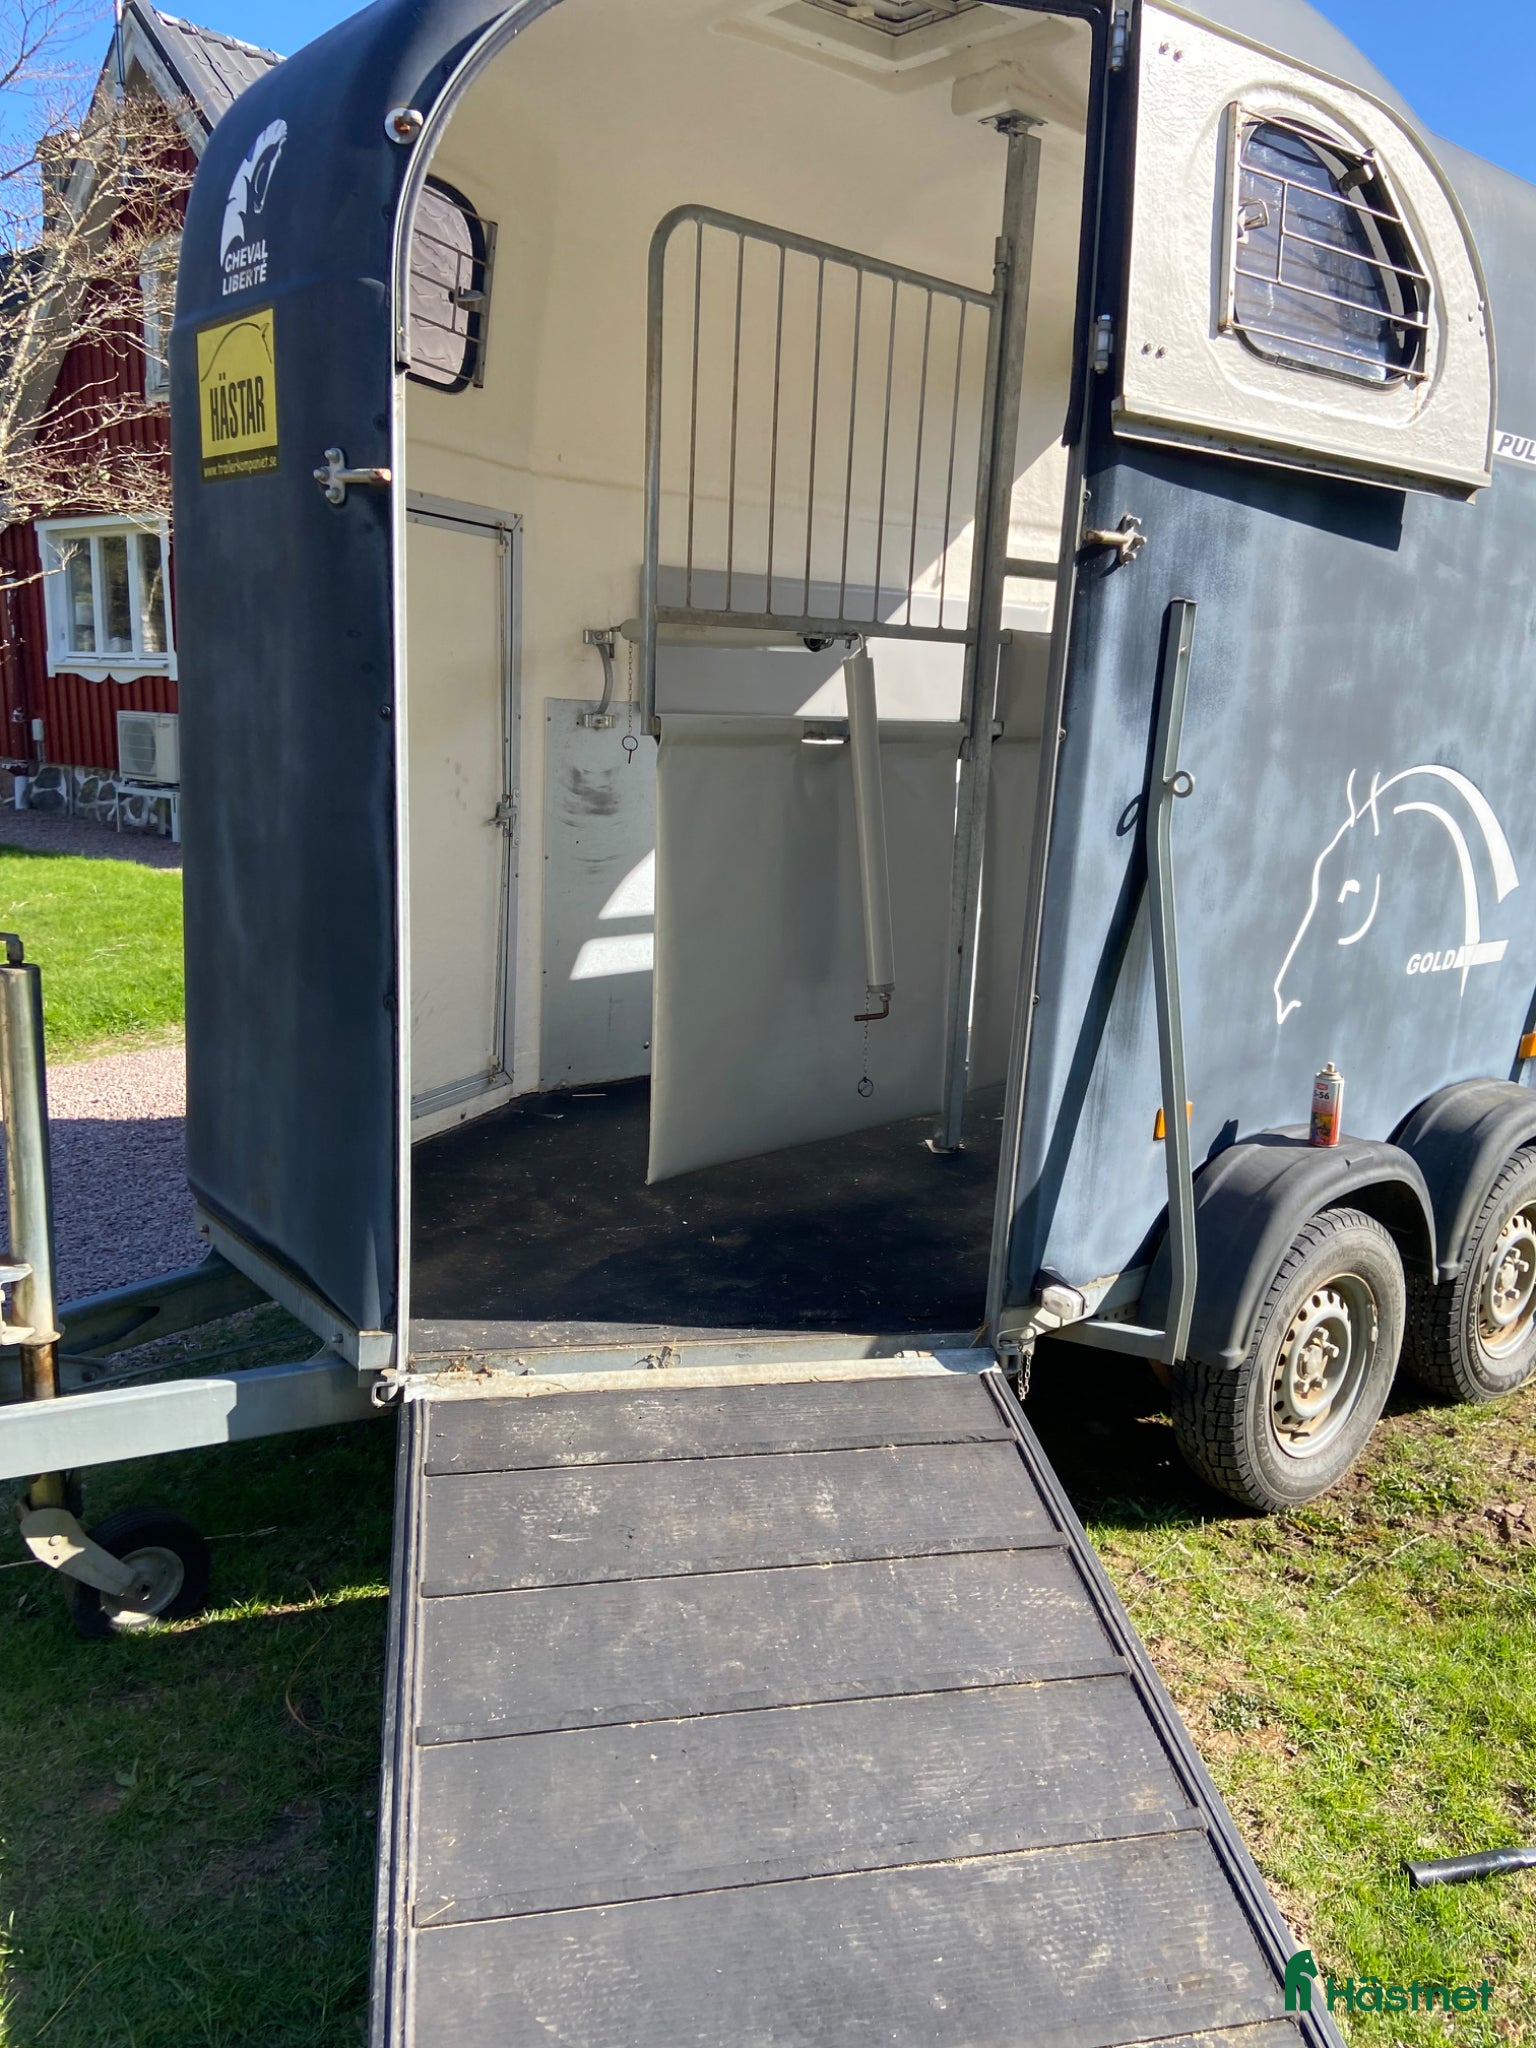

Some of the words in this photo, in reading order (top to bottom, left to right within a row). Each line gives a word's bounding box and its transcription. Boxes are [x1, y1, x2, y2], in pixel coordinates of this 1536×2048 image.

[224, 239, 268, 273] CHEVAL
[222, 259, 268, 297] LIBERTÉ
[209, 372, 266, 442] HÄSTAR
[1406, 949, 1456, 975] GOLD
